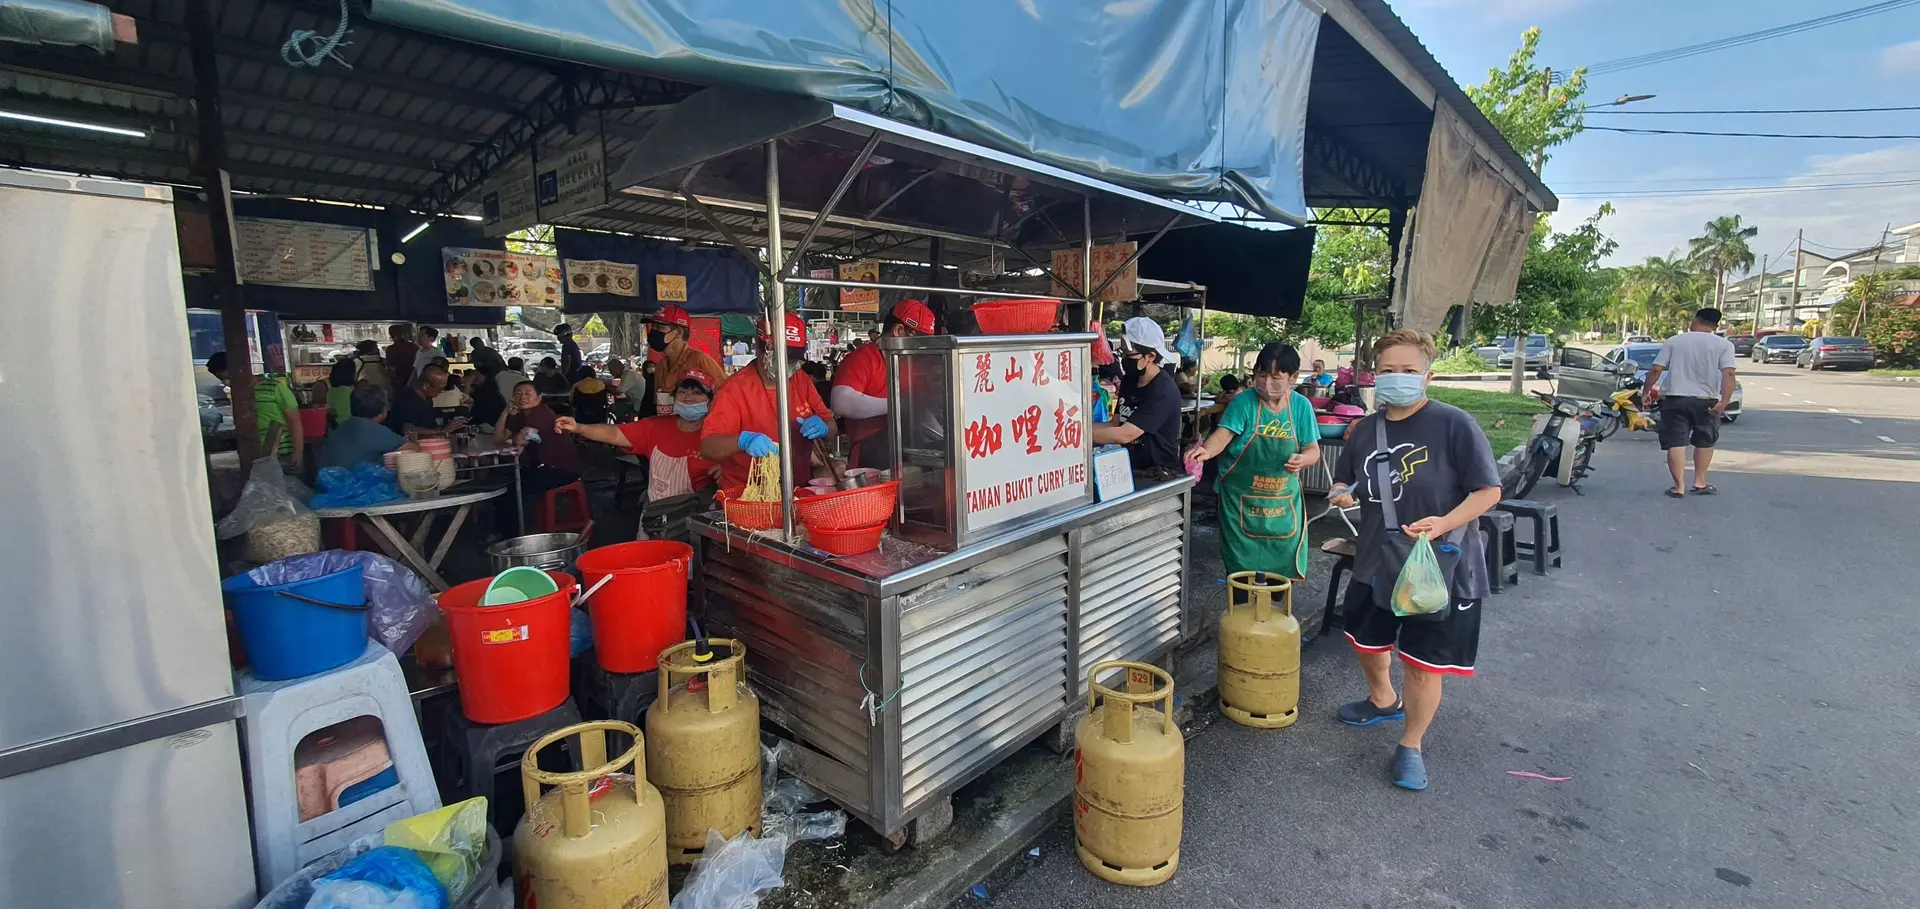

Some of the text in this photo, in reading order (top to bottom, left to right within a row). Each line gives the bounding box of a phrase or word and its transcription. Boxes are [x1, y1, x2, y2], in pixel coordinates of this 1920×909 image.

[660, 290, 684, 300] LAKSA
[974, 350, 1072, 394] 麗山花園
[966, 485, 1001, 514] TAMAN
[1005, 476, 1034, 504] BUKIT
[1038, 468, 1065, 494] CURRY
[1068, 463, 1085, 485] MEE
[1131, 672, 1149, 684] S29
